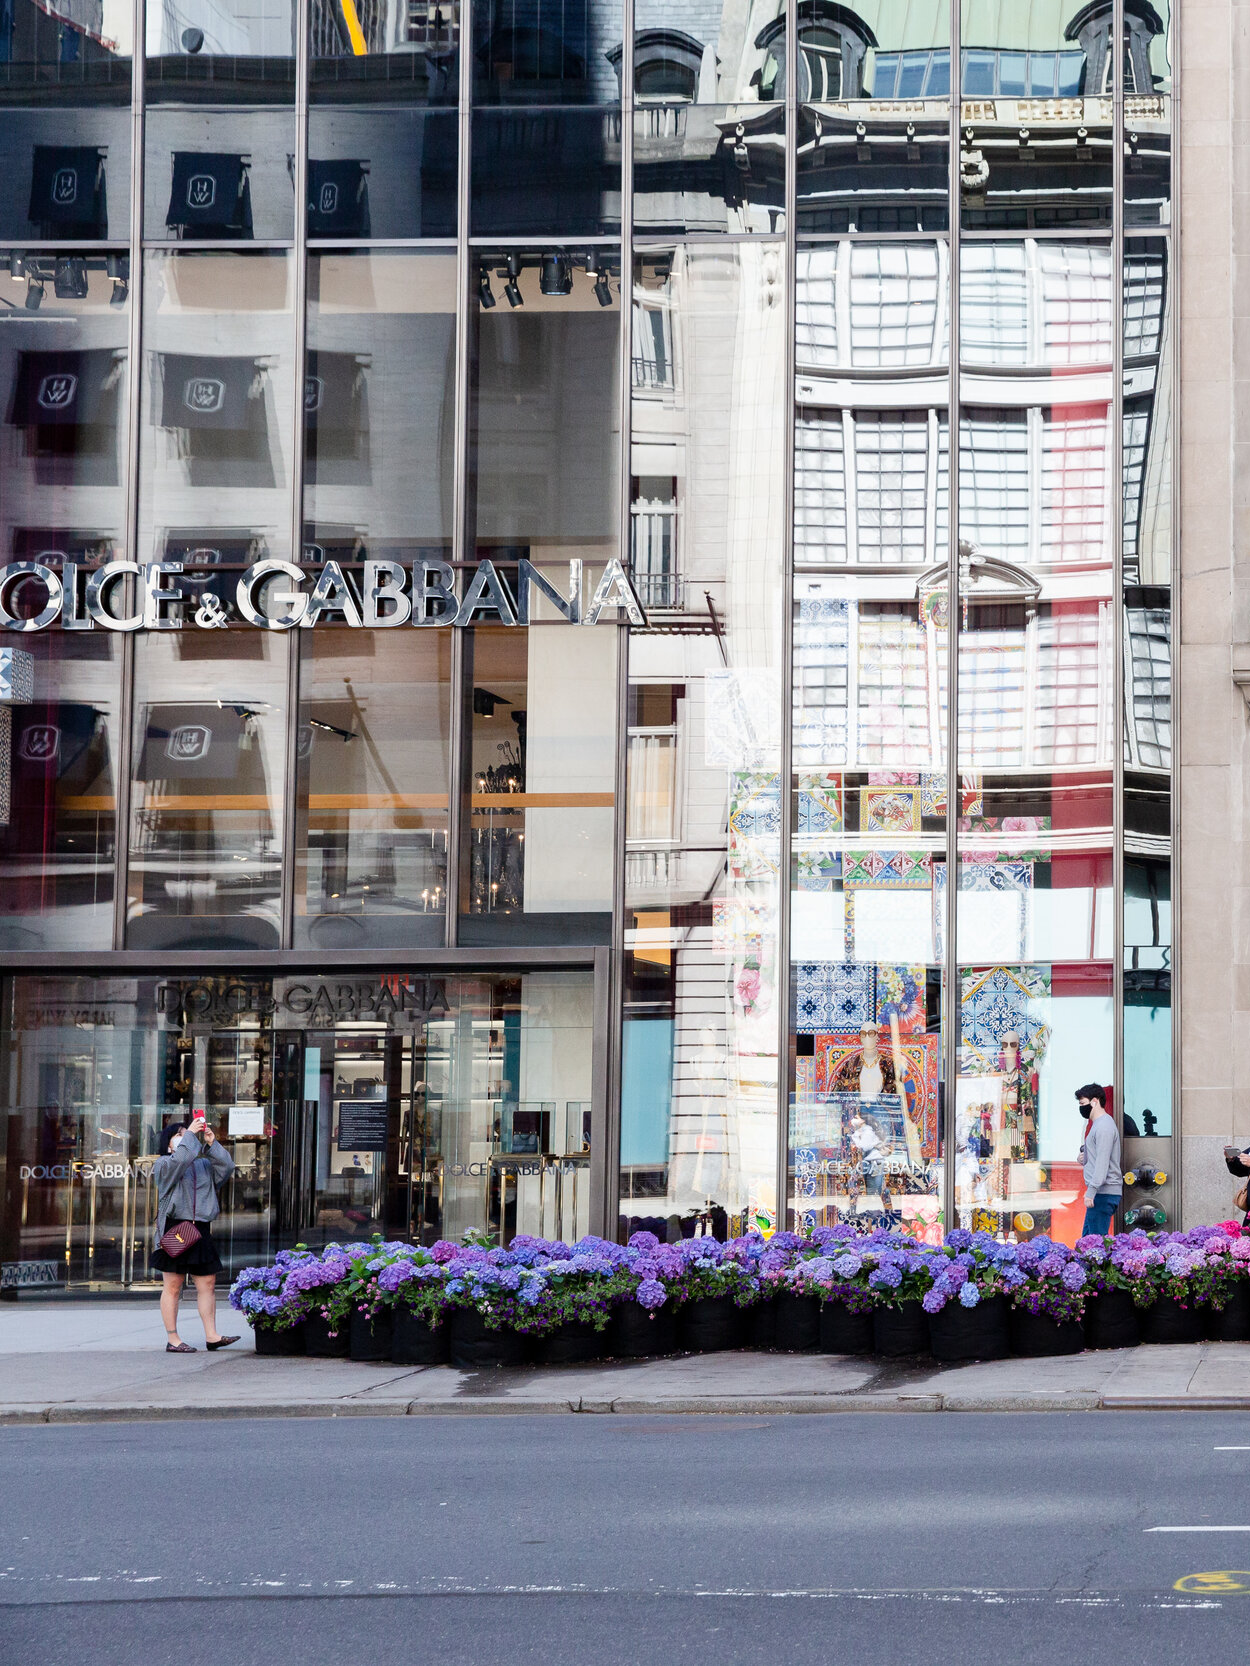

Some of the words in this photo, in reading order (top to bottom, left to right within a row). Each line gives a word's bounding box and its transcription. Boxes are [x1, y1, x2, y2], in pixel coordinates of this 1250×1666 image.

[0, 560, 184, 632] OLCE
[195, 592, 229, 628] &
[236, 558, 648, 630] GABBANA
[157, 984, 262, 1015] DOLCE
[282, 983, 450, 1014] GABBANA
[19, 1165, 70, 1180] DOLCE
[81, 1164, 157, 1180] GABBANA
[438, 1162, 488, 1177] DOLCE
[500, 1162, 577, 1177] GABBANA
[855, 1160, 932, 1175] GABBANA
